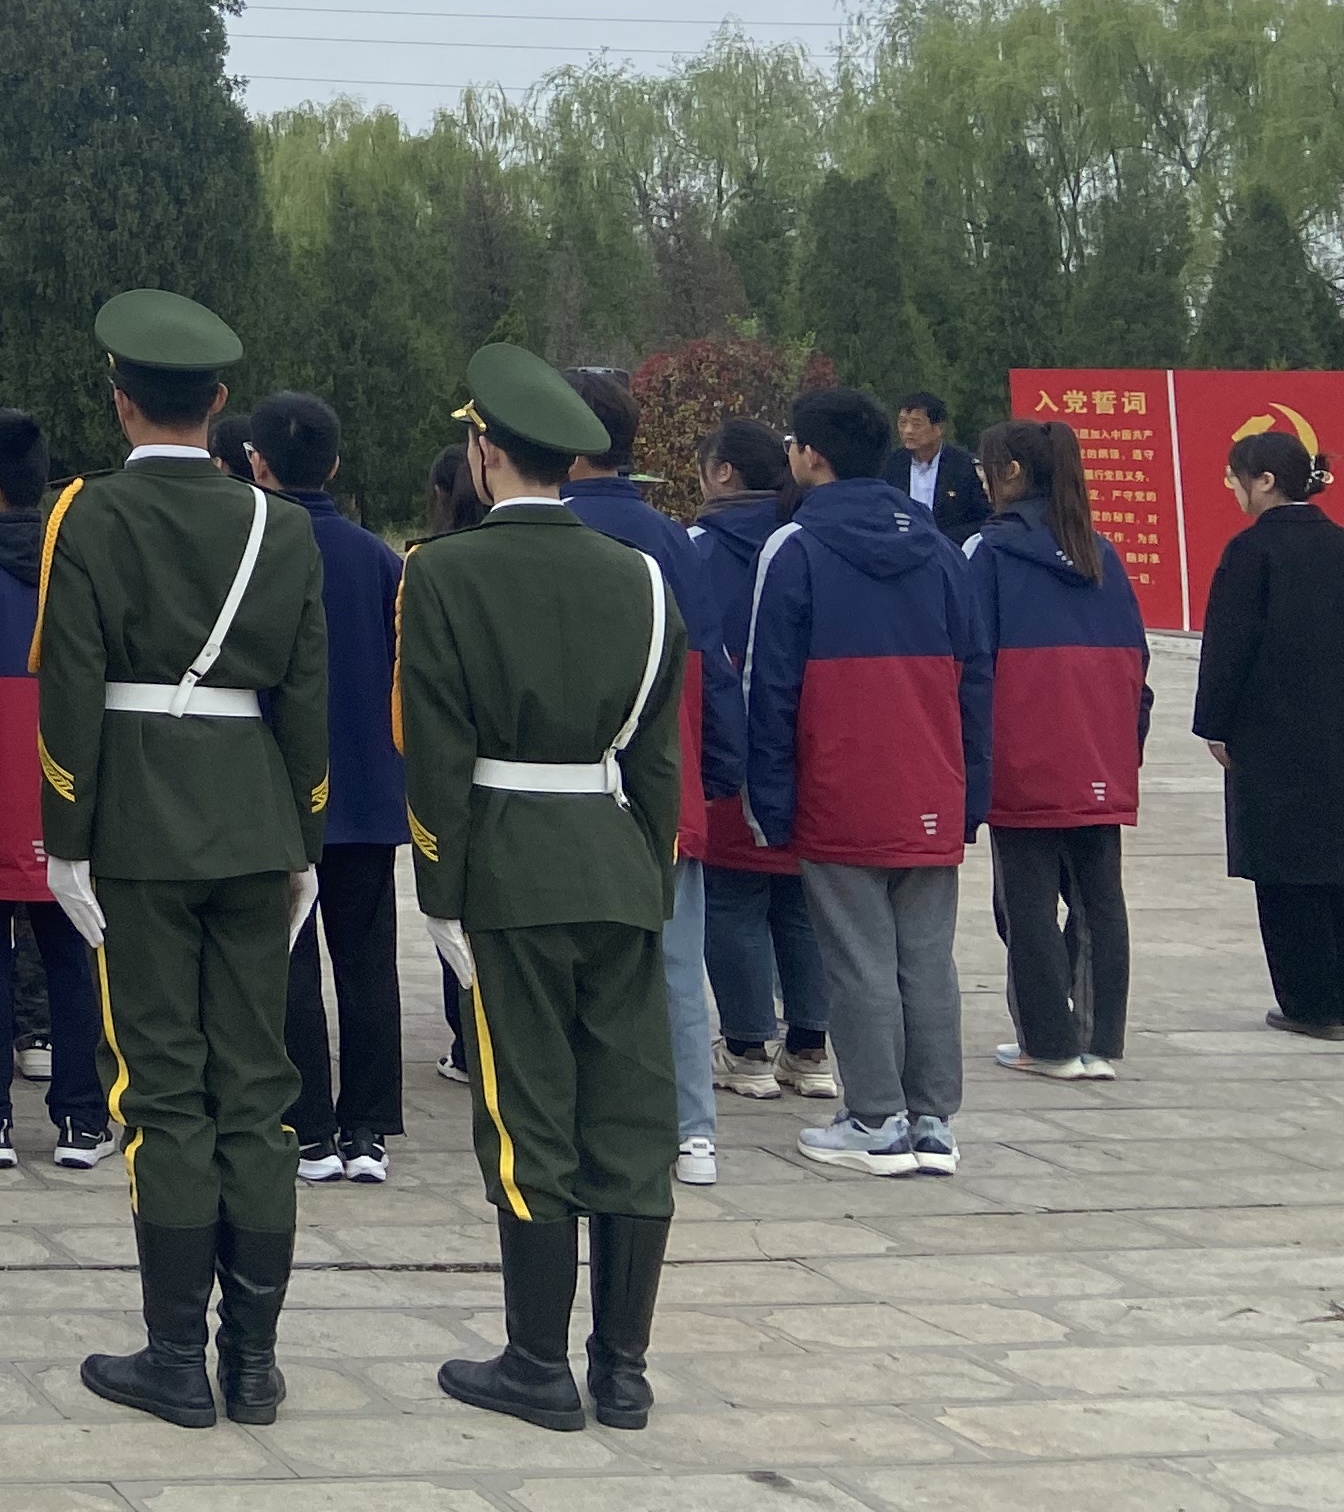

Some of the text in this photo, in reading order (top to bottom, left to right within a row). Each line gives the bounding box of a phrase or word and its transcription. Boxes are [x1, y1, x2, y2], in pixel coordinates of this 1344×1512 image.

[1034, 389, 1147, 415] 入党誓词
[1126, 552, 1160, 564] 随时准
